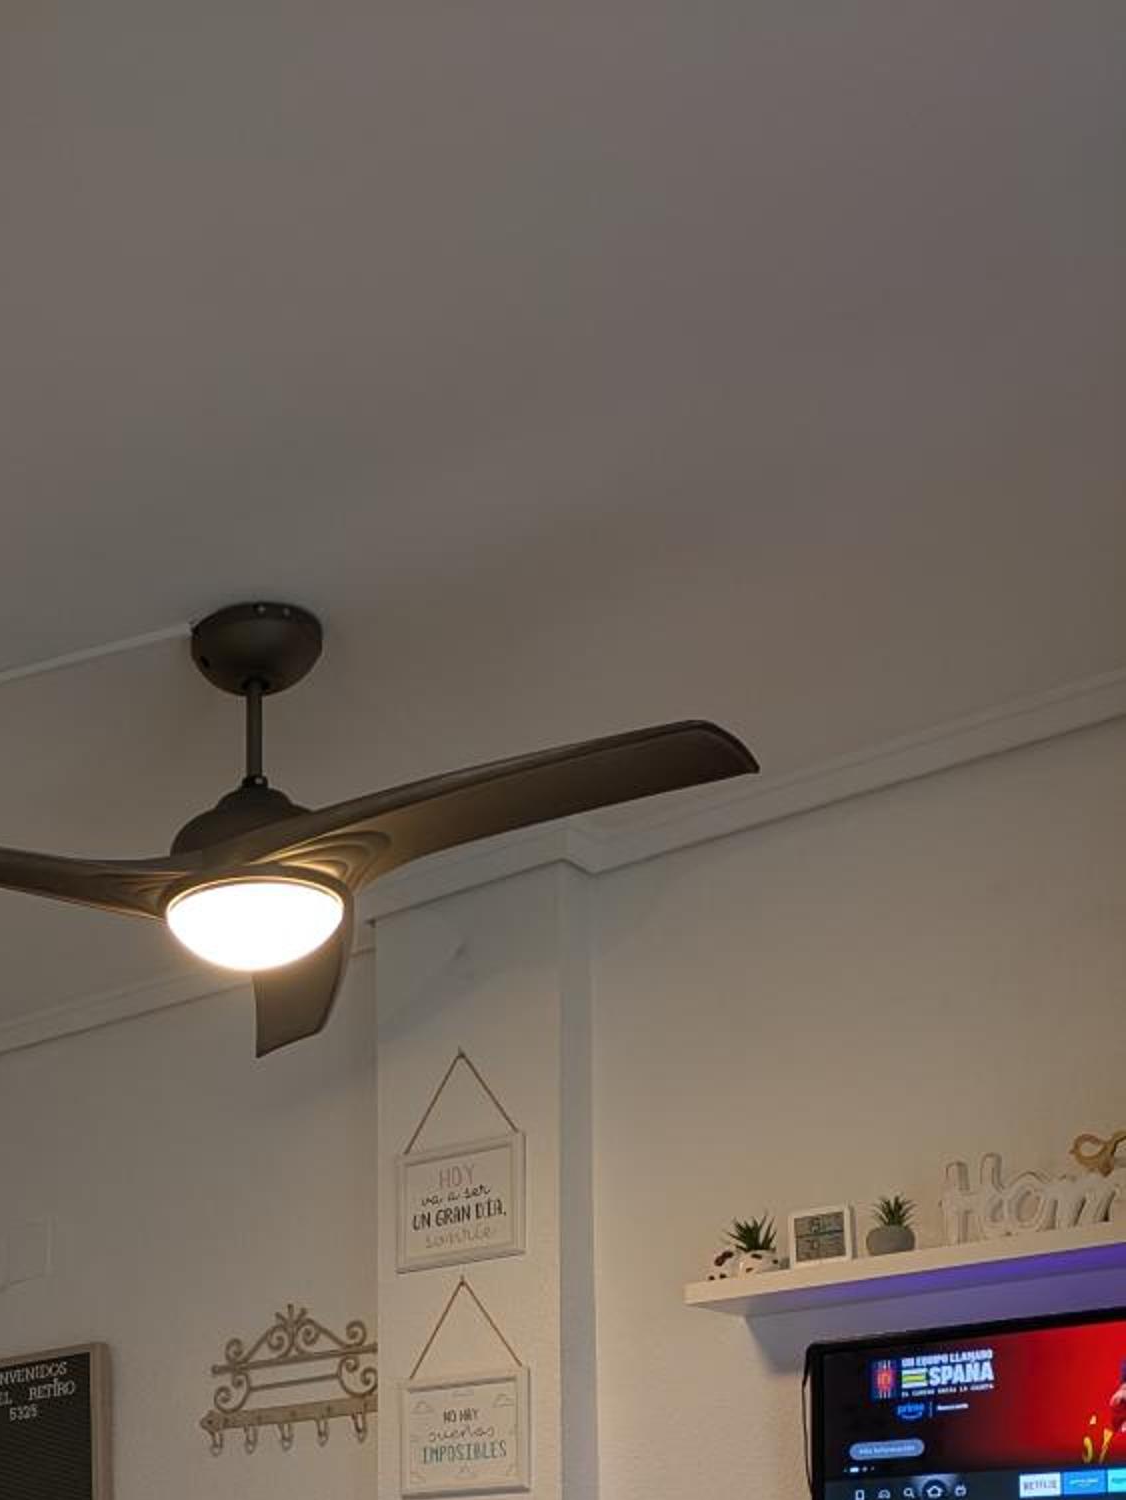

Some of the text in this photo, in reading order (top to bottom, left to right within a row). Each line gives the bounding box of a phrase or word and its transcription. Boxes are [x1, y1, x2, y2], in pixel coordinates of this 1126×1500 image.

[438, 1165, 474, 1188] HOY
[939, 1152, 1126, 1245] Hom
[413, 1211, 431, 1231] UN
[435, 1204, 471, 1227] GRAN
[422, 1440, 508, 1465] IMPOSIBLES
